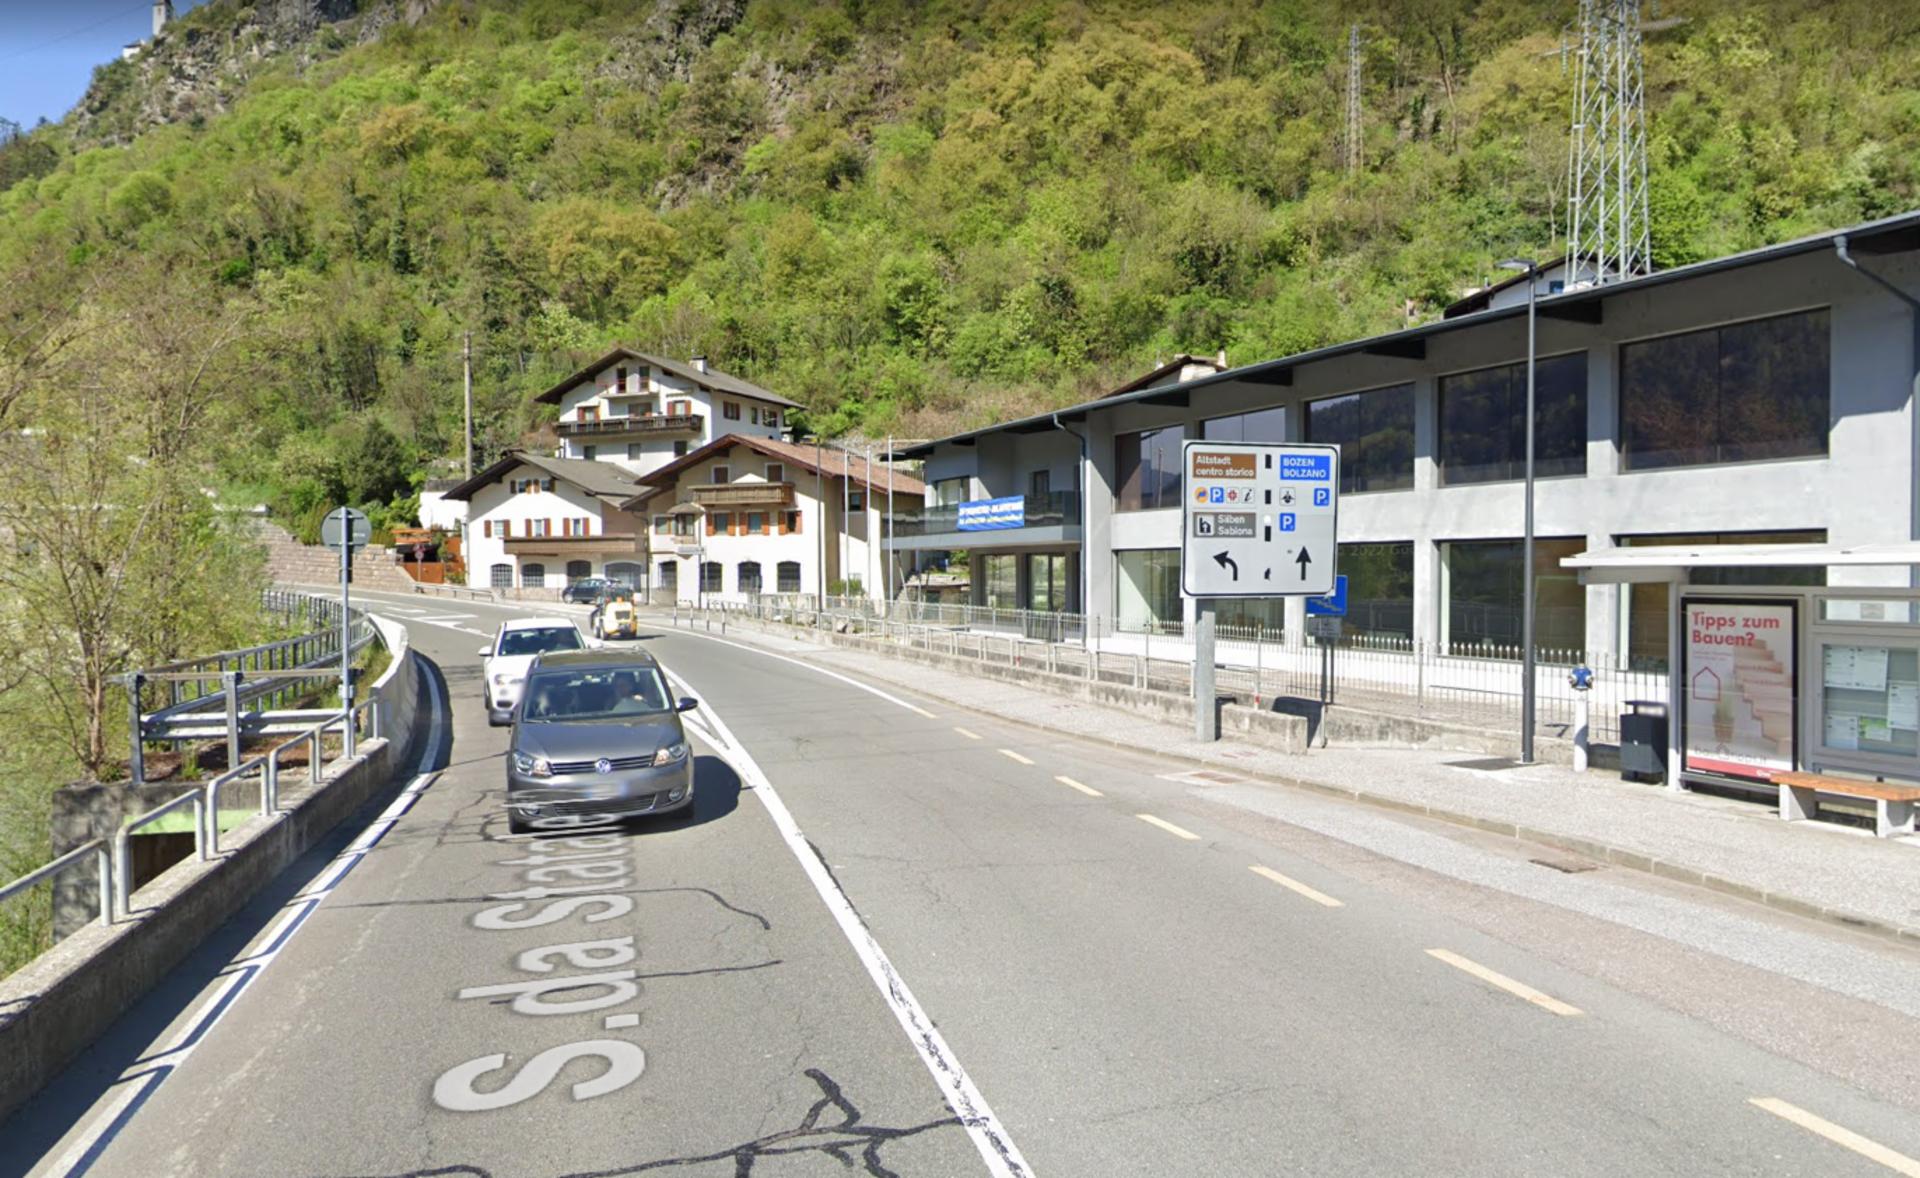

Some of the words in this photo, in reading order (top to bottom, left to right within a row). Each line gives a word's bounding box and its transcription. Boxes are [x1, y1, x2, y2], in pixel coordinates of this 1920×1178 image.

[1196, 455, 1232, 465] Altstadt
[1283, 457, 1315, 467] BOZEN
[1196, 467, 1224, 476] centro
[1225, 467, 1255, 477] storico
[1283, 468, 1327, 478] BOLZANO
[1692, 611, 1736, 631] Tipps
[1742, 617, 1780, 629] zum
[1692, 629, 1755, 647] Bauen?
